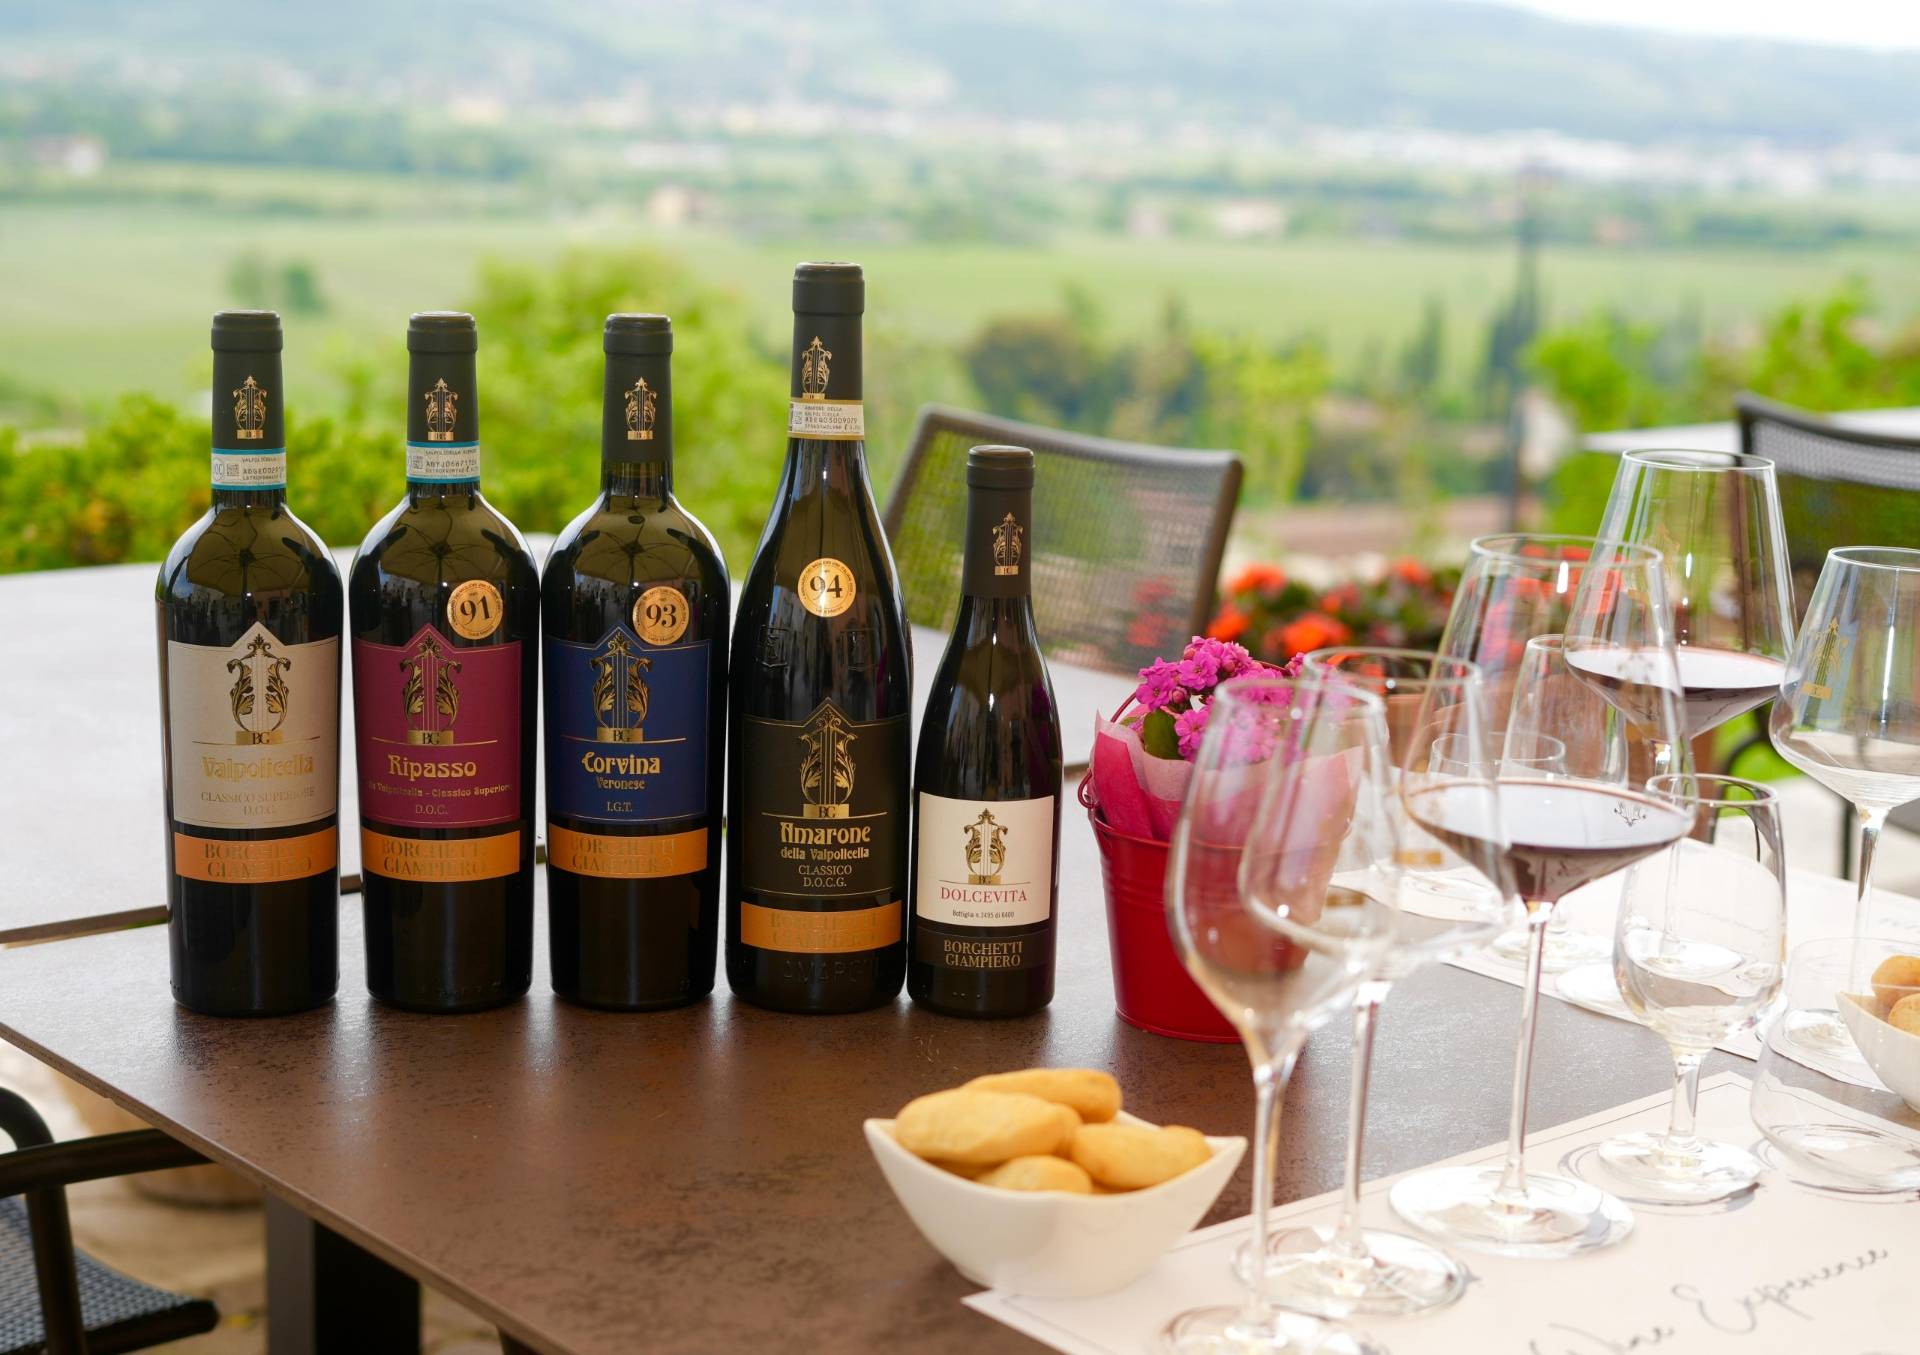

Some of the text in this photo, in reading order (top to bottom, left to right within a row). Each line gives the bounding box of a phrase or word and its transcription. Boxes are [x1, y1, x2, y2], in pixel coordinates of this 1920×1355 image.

[810, 574, 843, 600] 94
[460, 595, 492, 625] 91
[646, 604, 677, 628] 93
[203, 754, 314, 782] Valpolicella
[388, 753, 477, 781] Ripasso
[581, 751, 662, 775] Corvina
[596, 777, 646, 790] Veronese
[432, 788, 471, 798] Classico
[415, 804, 448, 815] D.O.C.
[607, 801, 633, 812] I.G.T.
[780, 822, 871, 845] Amarone
[781, 847, 870, 862] della Valpolicella
[798, 865, 853, 876] CLASSICO
[803, 877, 847, 887] D.O.C.G.
[941, 887, 1027, 903] DOLCEVITA
[944, 940, 1023, 956] BORGHETTI
[945, 954, 1021, 968] GIAMPIERO
